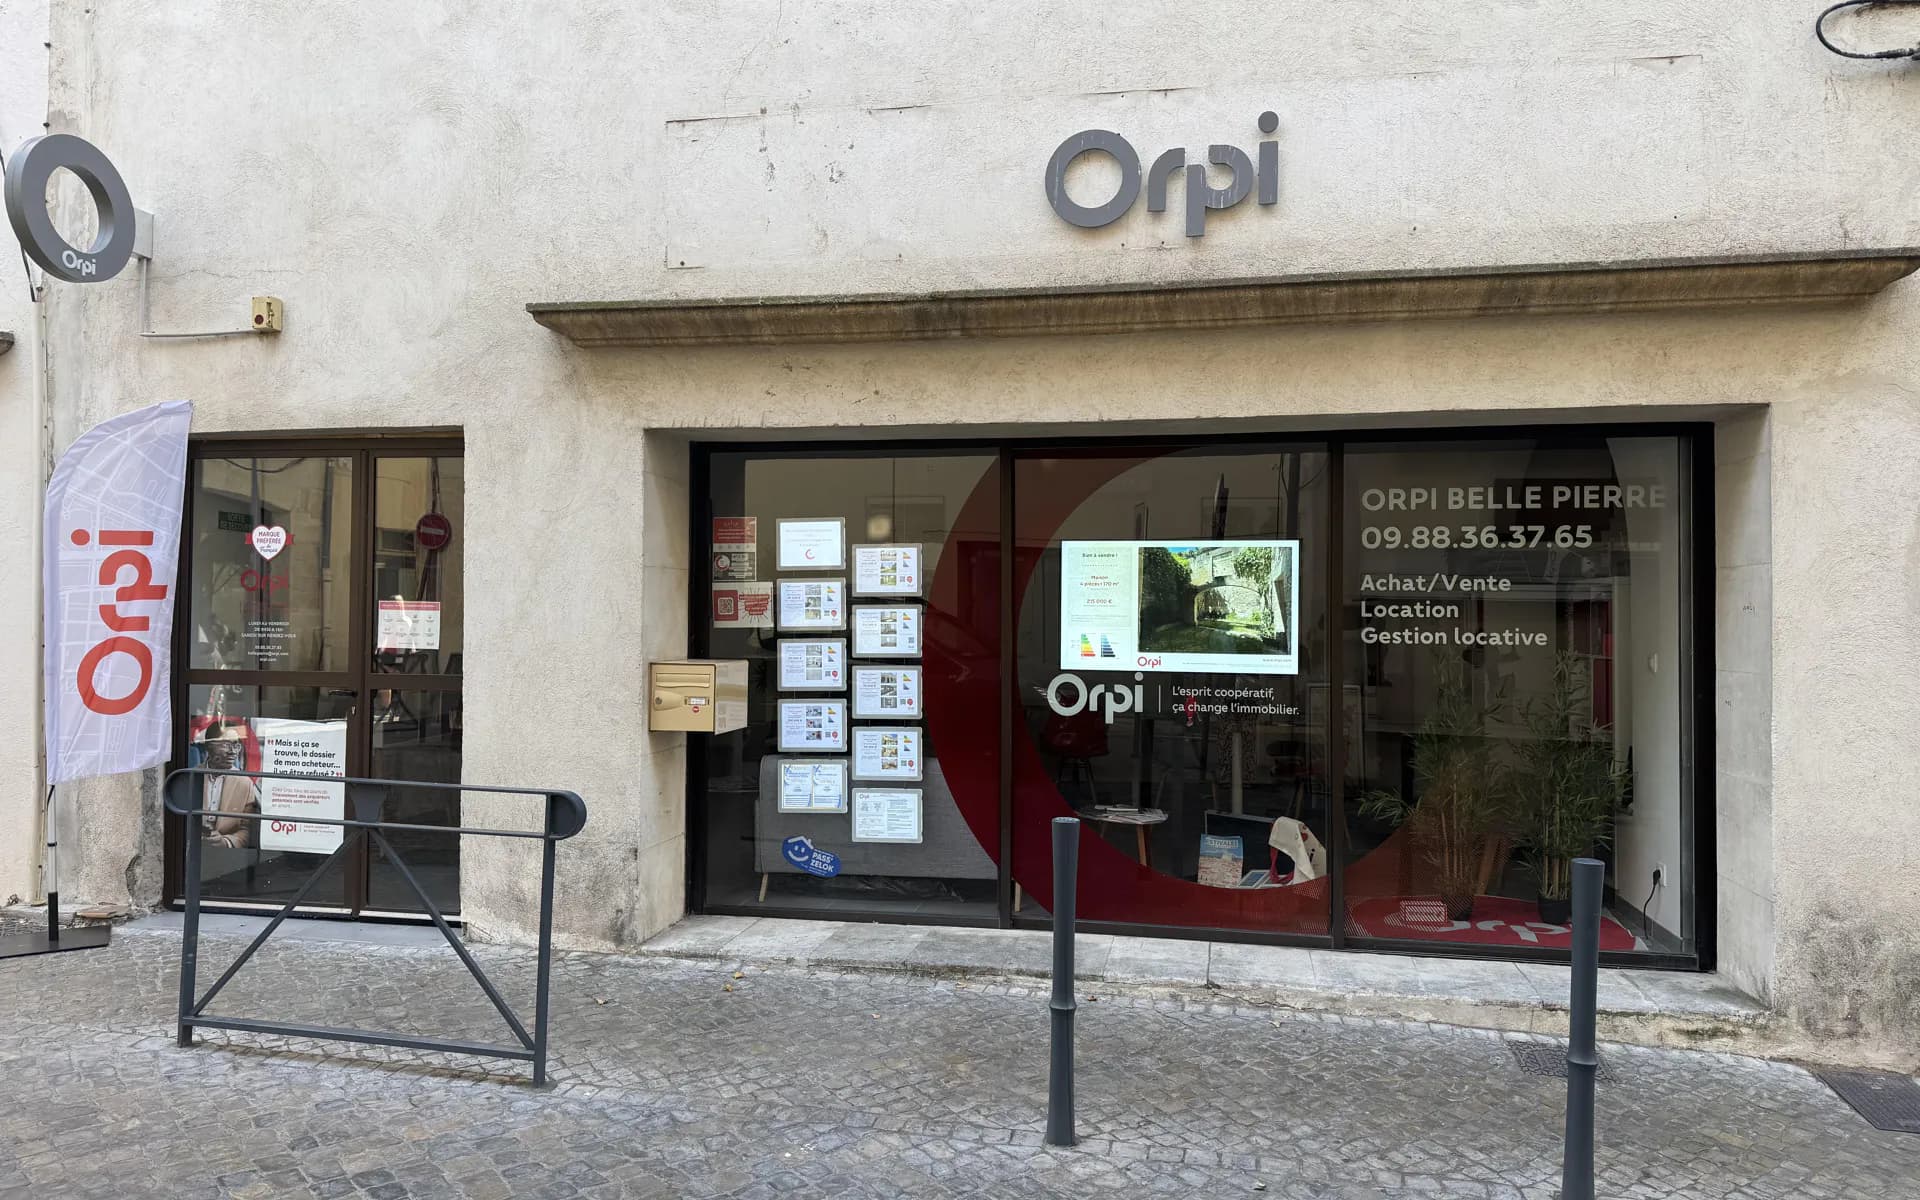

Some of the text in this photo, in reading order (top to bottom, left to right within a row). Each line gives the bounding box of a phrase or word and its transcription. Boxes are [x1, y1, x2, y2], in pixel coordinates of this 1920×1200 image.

[1045, 111, 1279, 237] Orpi
[62, 250, 96, 276] Orpi
[1361, 484, 1666, 511] ORPI BELLE PIERRE
[1361, 524, 1593, 549] 09.88.36.37.65
[241, 568, 289, 596] Orpi
[1360, 573, 1512, 592] Achat/Vente
[1360, 600, 1460, 618] Location
[70, 528, 168, 716] Orpi
[1360, 627, 1549, 647] Gestion locative
[1137, 655, 1162, 668] Orpi
[1047, 671, 1144, 724] Orpi
[1172, 686, 1275, 701] L’esprit coopératif,
[1172, 702, 1301, 716] ça change l’immobilier.
[293, 739, 300, 747] si
[300, 741, 310, 749] ça
[273, 758, 283, 766] de
[301, 760, 341, 769] acheteur...
[274, 749, 300, 758] trouve,
[309, 751, 336, 759] dossier
[810, 859, 835, 873] ZELOK
